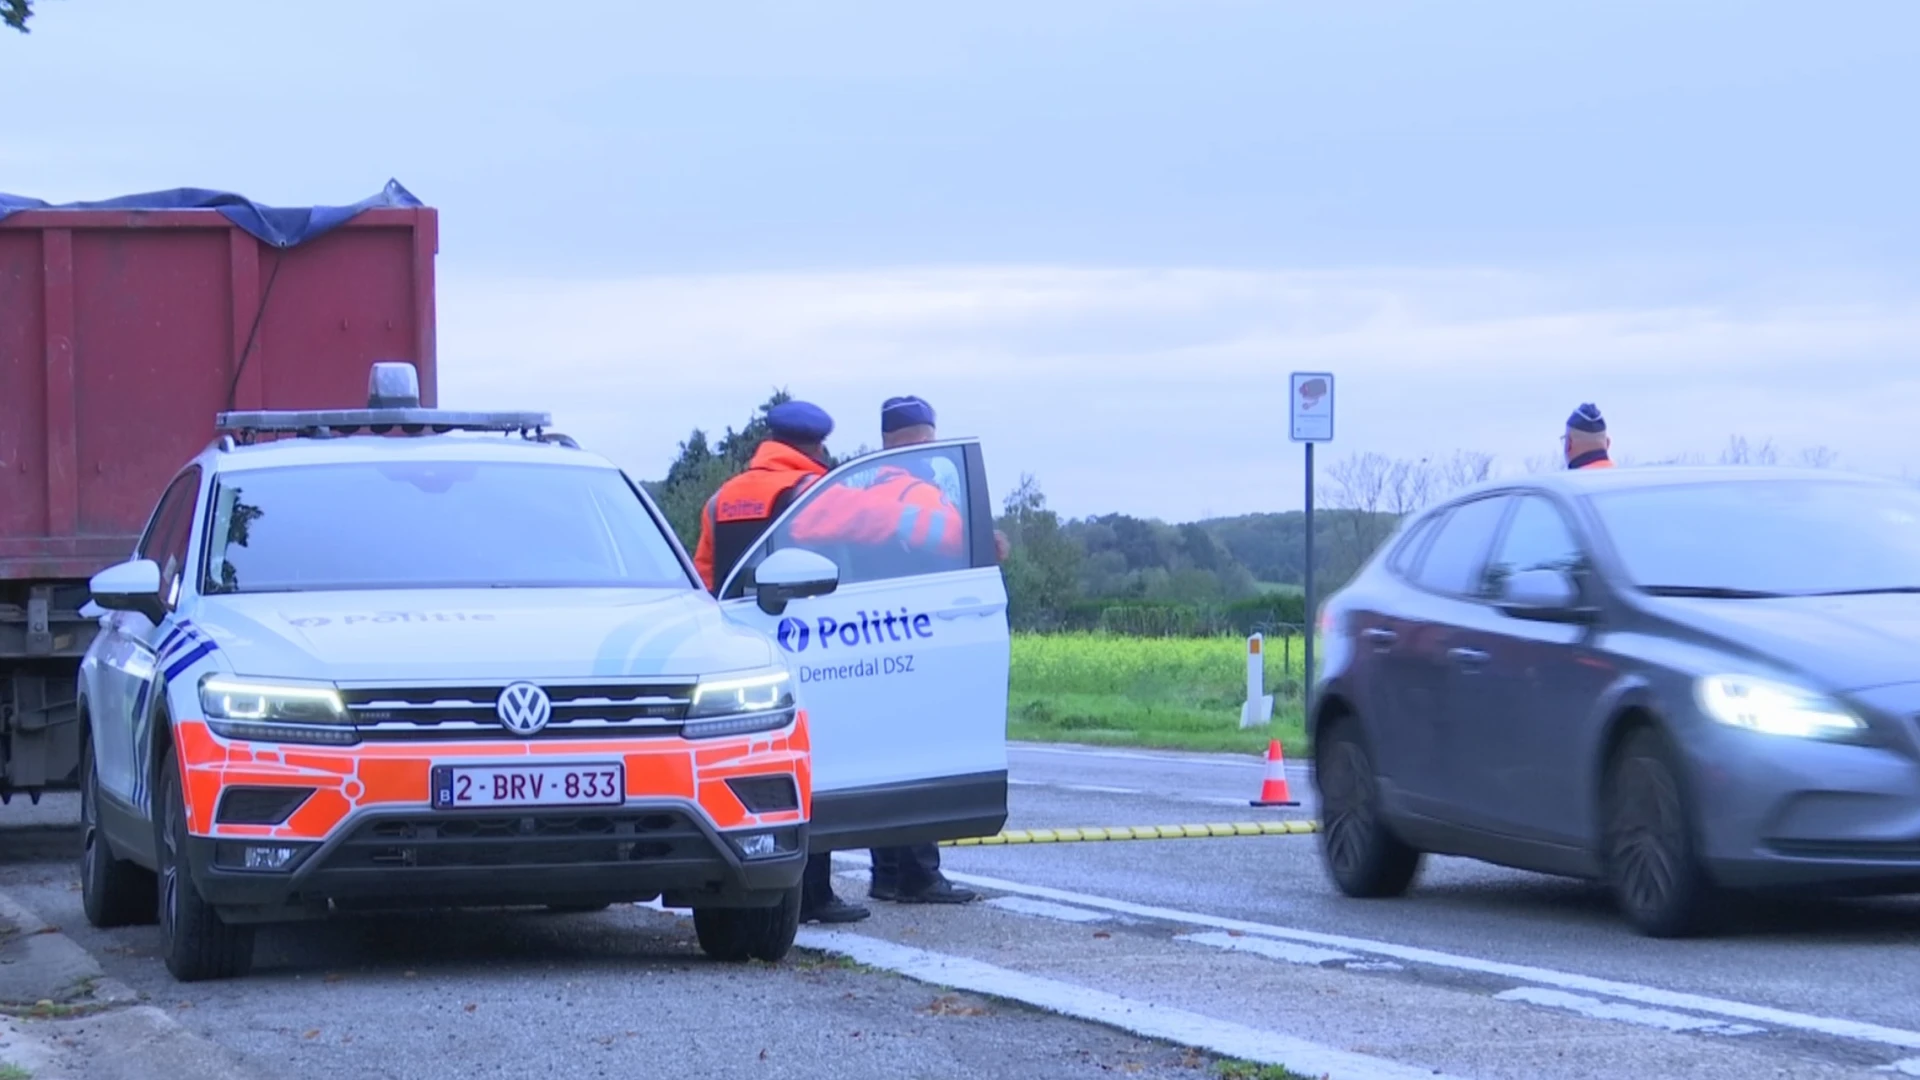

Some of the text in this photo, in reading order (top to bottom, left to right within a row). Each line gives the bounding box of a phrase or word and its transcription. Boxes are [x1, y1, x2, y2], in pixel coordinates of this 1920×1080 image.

[816, 606, 934, 650] Politie
[800, 655, 915, 683] Demerdal DSZ
[440, 790, 450, 802] B
